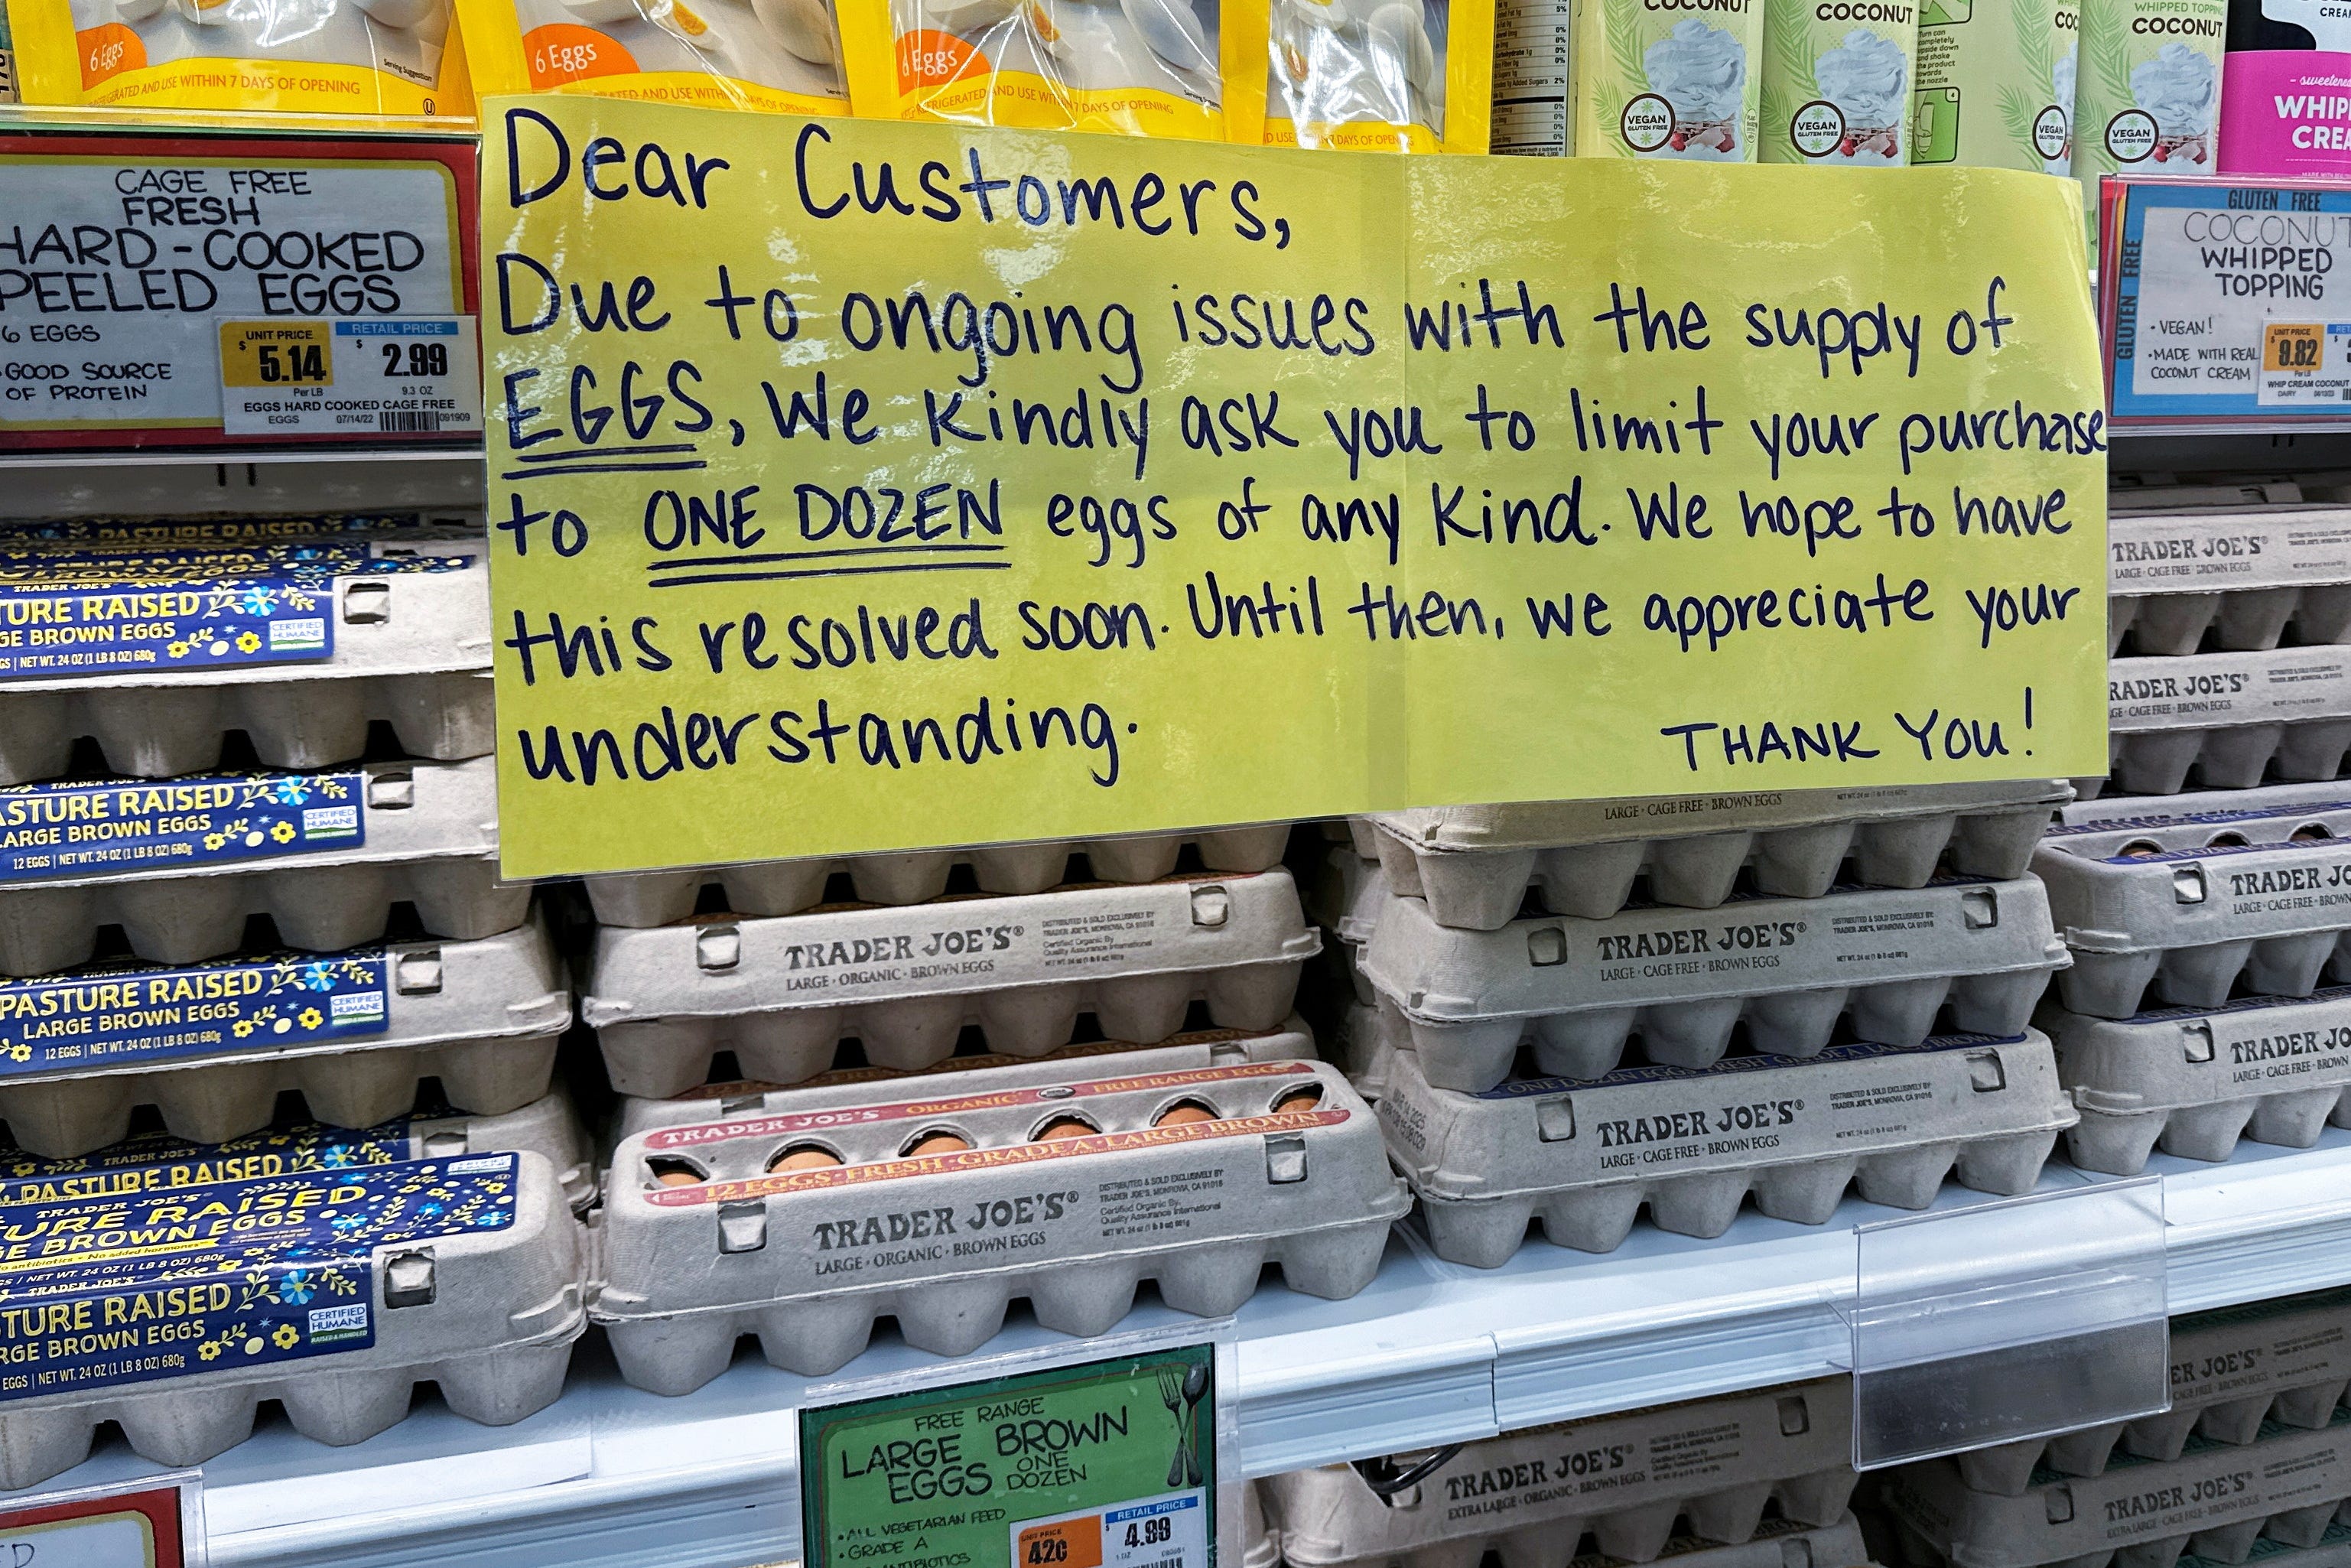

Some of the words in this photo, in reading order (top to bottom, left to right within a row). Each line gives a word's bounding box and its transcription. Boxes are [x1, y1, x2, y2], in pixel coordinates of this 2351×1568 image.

[1816, 3, 1913, 24] COCONUT
[2135, 2, 2187, 13] WHIPPED
[2132, 17, 2223, 38] COCONUT
[91, 47, 99, 70] 6
[100, 41, 124, 70] Eggs
[535, 49, 546, 73] 6
[549, 44, 597, 73] Eggs
[912, 48, 957, 76] Eggs
[141, 80, 160, 94] AND
[161, 76, 177, 89] USE
[180, 75, 226, 88] WITHIN
[230, 76, 236, 88] 7
[241, 76, 274, 89] DAYS
[278, 77, 296, 90] OF
[299, 78, 360, 94] OPENING
[1627, 114, 1667, 125] VEGAN
[1797, 121, 1837, 132] VEGAN
[2039, 125, 2063, 135] VEGAN
[2112, 128, 2151, 138] VEGAN
[115, 168, 208, 196] CAGE
[229, 169, 312, 196] FREE
[505, 108, 730, 210] Dear
[795, 123, 1291, 250] Customers,
[122, 197, 261, 226] FRESH
[2228, 190, 2278, 210] GLUTEN
[2291, 192, 2322, 212] FREE
[2201, 247, 2333, 274] WHIPPED
[0, 269, 217, 314] PEELED
[257, 272, 402, 315] EGGS
[2215, 274, 2323, 300] TOPPING
[246, 330, 274, 340] UNIT
[277, 330, 313, 340] PRICE
[352, 324, 398, 333] RETAIL
[402, 324, 443, 333] PRICE
[496, 253, 671, 336] Due
[704, 265, 800, 342] to
[841, 291, 1145, 395] ongoing
[1171, 283, 1376, 356] issues
[1405, 278, 1566, 353] with
[1593, 282, 1712, 353] the
[1745, 302, 1921, 379] supply
[1946, 275, 2014, 356] of
[259, 345, 327, 382] 5.14
[382, 343, 447, 377] 2.99
[2154, 348, 2190, 361] MADE
[2197, 349, 2226, 360] WITH
[2231, 348, 2260, 361] REAL
[2151, 367, 2198, 379] COCONUT
[2207, 366, 2251, 380] CREAM
[6, 388, 37, 401] OF
[50, 384, 148, 402] PROTEIN
[244, 402, 281, 412] EGGS
[285, 402, 320, 412] HARD
[325, 401, 379, 410] COOKED
[383, 400, 419, 410] CAGE
[422, 399, 455, 408] FREE
[293, 388, 309, 397] Per
[311, 388, 324, 396] LB
[503, 359, 746, 451] EGGS,
[1181, 390, 1300, 457] ask
[1324, 405, 1443, 482] you
[1465, 384, 1536, 451] to
[1570, 387, 1724, 456] limit
[1750, 412, 1880, 481] your
[1900, 399, 2108, 476] purchase
[496, 493, 589, 557] to
[643, 484, 766, 551] ONE
[792, 477, 1003, 543] DOZEN
[1047, 493, 1178, 569] eggs
[1218, 476, 1272, 541] of
[1302, 493, 1400, 566] any
[1626, 481, 1713, 541] We
[1738, 490, 1862, 557] hope
[1877, 486, 1936, 538] to
[1953, 486, 2073, 538] have
[83, 592, 200, 623] RAISED
[30, 625, 115, 646] BROWN
[121, 622, 176, 640] EGGS
[504, 610, 674, 687] this
[698, 597, 1000, 674] resolved
[1017, 600, 1170, 651] soon.
[1186, 571, 1325, 639] Until
[1347, 581, 1504, 641] then,
[1525, 592, 1612, 640] we
[1642, 572, 1935, 653] appreciate
[1965, 583, 2081, 649] your
[518, 696, 1139, 788] understanding.
[1660, 721, 1881, 772] THANK
[119, 783, 234, 814] RAISED
[1605, 806, 1639, 821] LARGE
[1647, 802, 1677, 816] CAGE
[1679, 799, 1704, 813] FREE
[1712, 795, 1754, 811] BROWN
[1754, 792, 1783, 808] EGGS
[67, 818, 151, 842] BROWN
[158, 814, 212, 834] EGGS
[2230, 867, 2322, 897] TRADER
[784, 935, 915, 971] TRADER
[1596, 929, 1711, 961] TRADER
[786, 975, 830, 991] LARGE
[838, 968, 902, 987] ORGANIC
[911, 964, 962, 981] BROWN
[963, 959, 994, 976] EGGS
[1601, 967, 1636, 982] LARGE
[1643, 963, 1673, 978] CAGE
[1675, 961, 1700, 977] FREE
[1708, 957, 1750, 972] BROWN
[1752, 955, 1780, 969] EGGS
[24, 1017, 93, 1040] LARGE
[99, 1007, 181, 1031] BROWN
[187, 1002, 240, 1023] EGGS
[2229, 1031, 2320, 1065] TRADER
[1595, 1109, 1711, 1148] TRADER
[1600, 1153, 1636, 1170] LARGE
[1643, 1147, 1673, 1164] CAGE
[1674, 1143, 1699, 1160] FREE
[1708, 1138, 1750, 1156] BROWN
[1752, 1134, 1780, 1150] EGGS
[146, 1185, 367, 1225] RAISED
[41, 1225, 199, 1257] BROWN
[209, 1209, 307, 1236] EGGS
[814, 1206, 955, 1252] TRADER
[103, 1283, 231, 1326] RAISED
[310, 1306, 366, 1321] CERTIFIED
[311, 1314, 366, 1329] HUMANE
[47, 1327, 139, 1358] BROWN
[149, 1319, 206, 1343] EGGS
[914, 1411, 964, 1433] FREE
[977, 1397, 1045, 1423] RANGE
[841, 1433, 964, 1480] LARGE
[996, 1405, 1129, 1456] BROWN
[1016, 1450, 1069, 1472] ONE
[887, 1462, 993, 1505] EGGS
[1006, 1464, 1088, 1492] DOZEN
[1117, 1506, 1153, 1520] RETAIL
[1156, 1499, 1186, 1511] PRICE
[1124, 1516, 1171, 1548] 4.99
